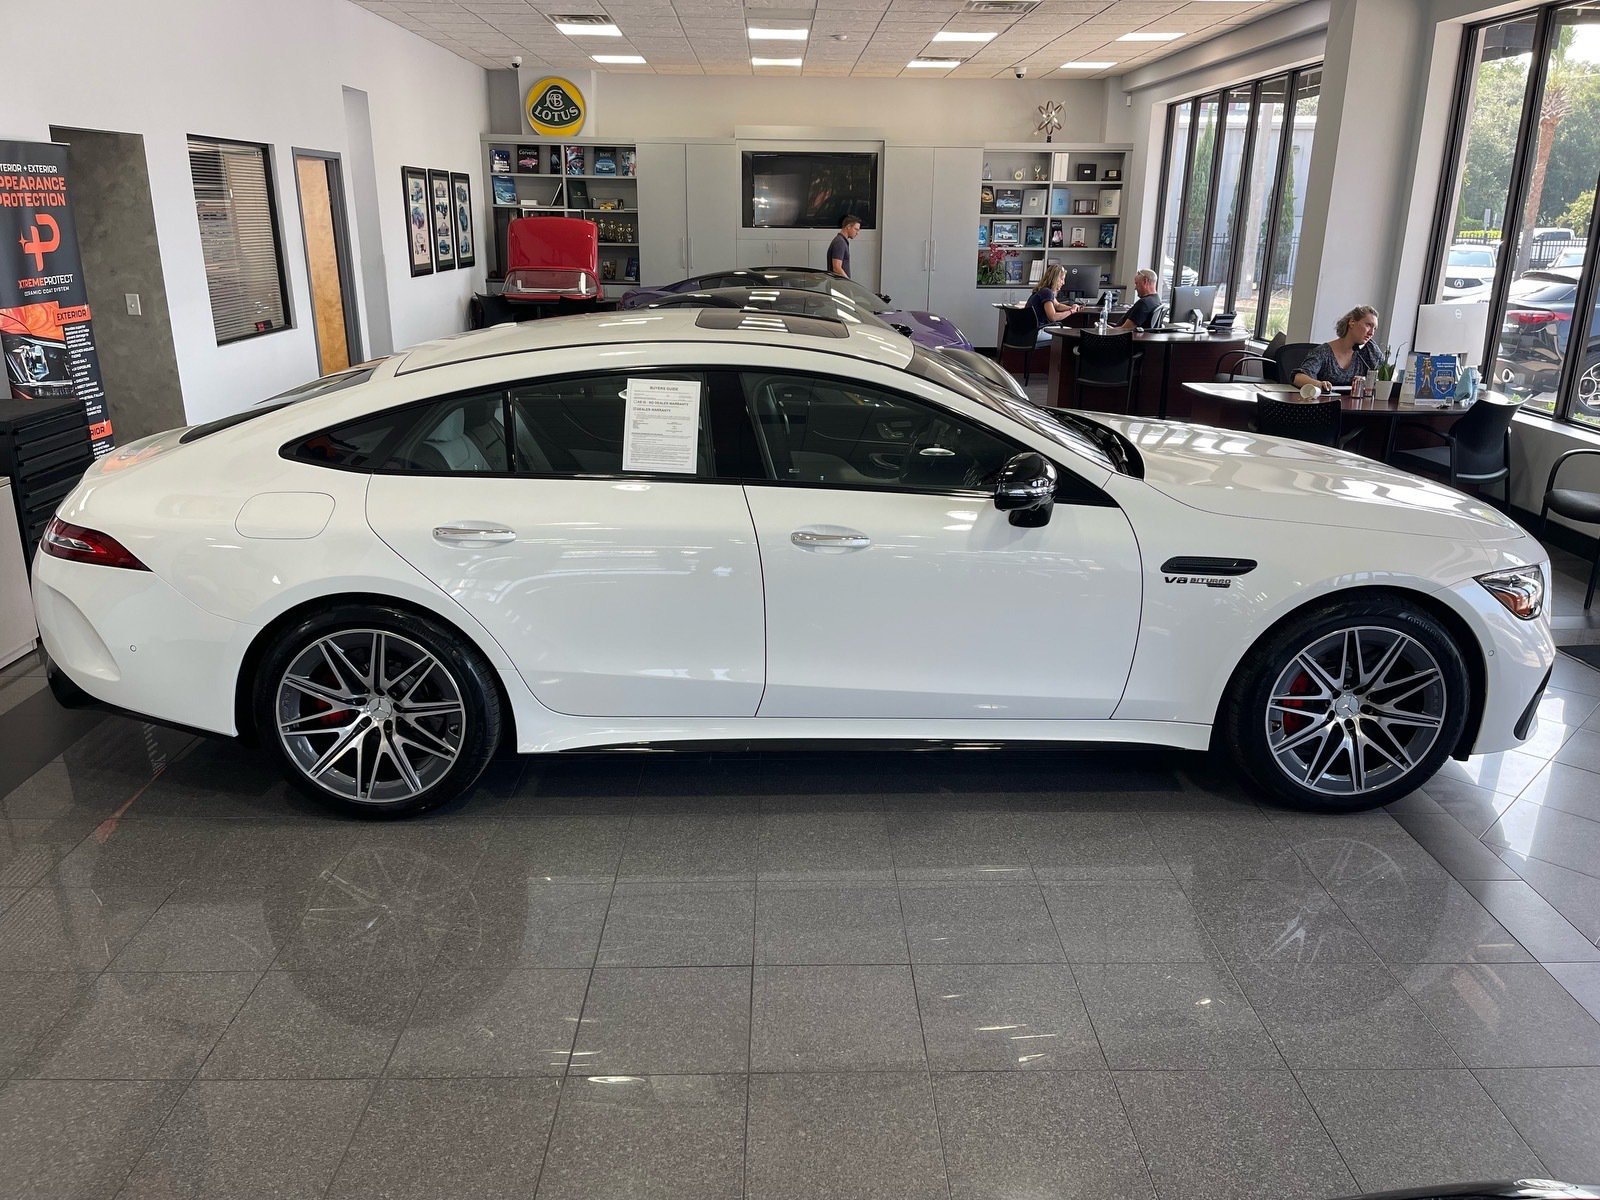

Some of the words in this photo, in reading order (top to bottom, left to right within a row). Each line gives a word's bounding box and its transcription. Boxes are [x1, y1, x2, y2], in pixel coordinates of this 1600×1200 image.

[534, 106, 579, 122] LOTUS
[28, 164, 58, 174] EXTERIOR
[17, 274, 74, 289] XTREMEPROTECT
[57, 309, 87, 321] EXTERIOR
[1165, 576, 1188, 584] V8
[1190, 577, 1231, 585] BITURBO
